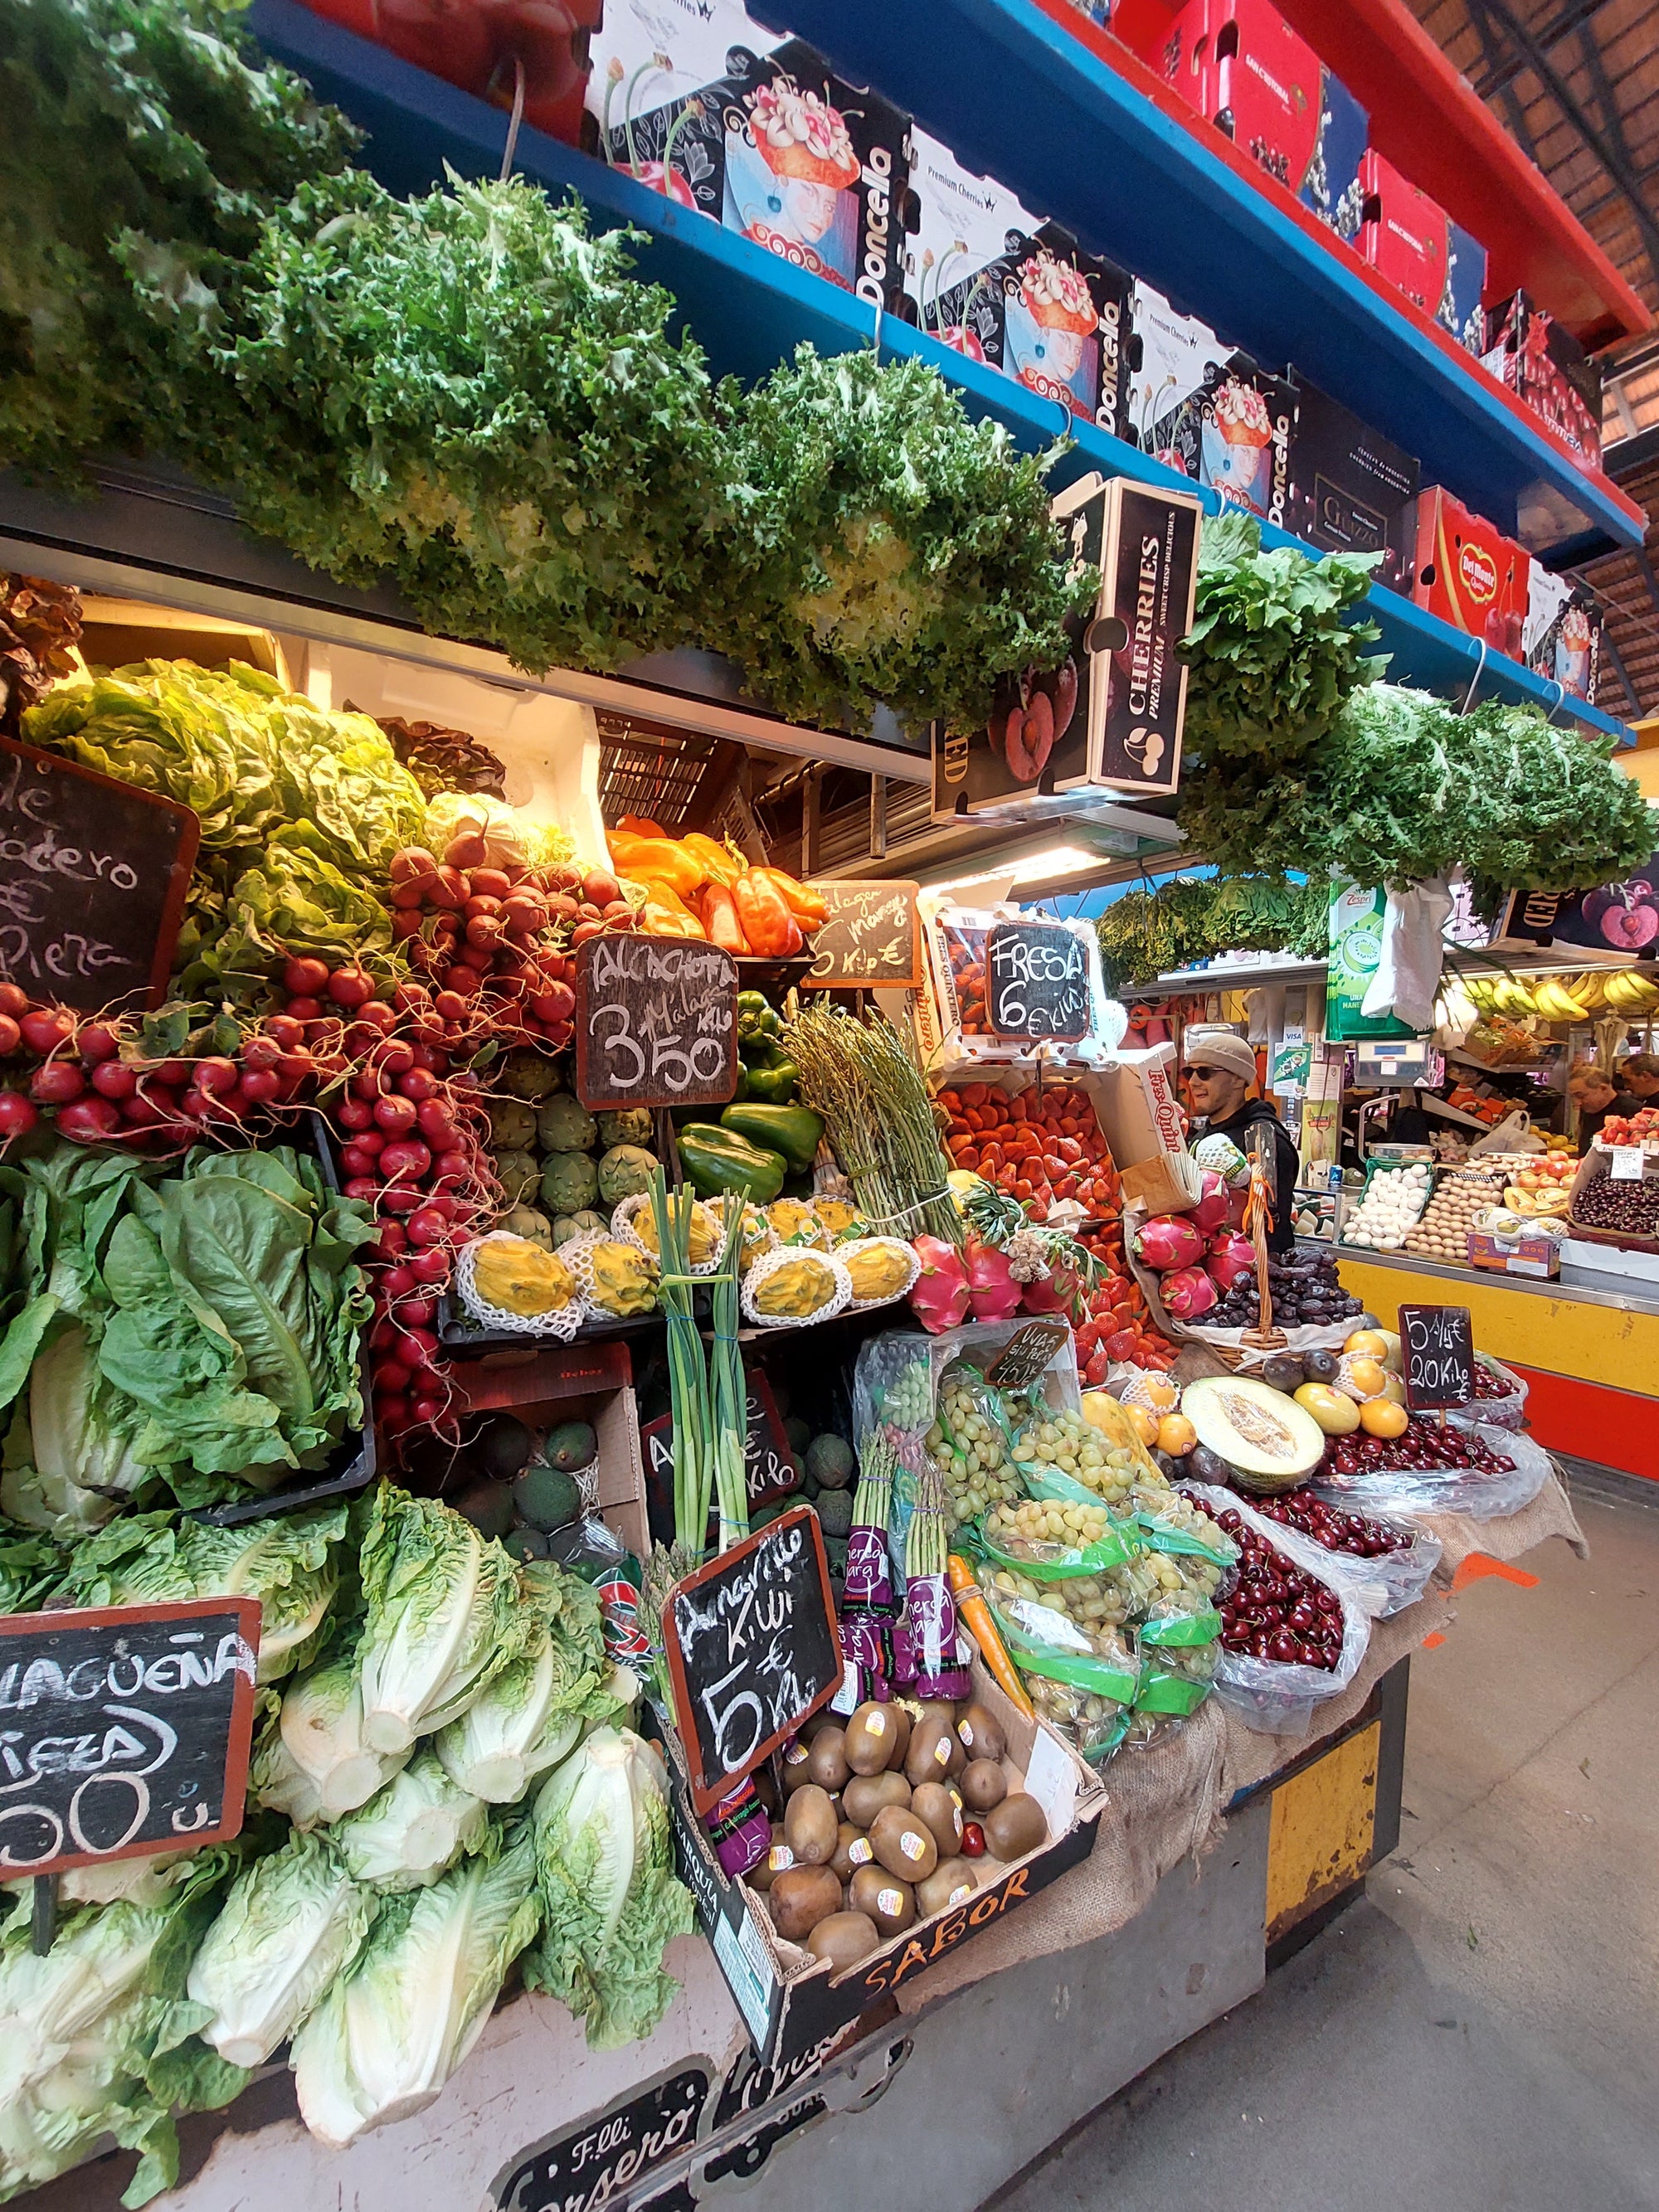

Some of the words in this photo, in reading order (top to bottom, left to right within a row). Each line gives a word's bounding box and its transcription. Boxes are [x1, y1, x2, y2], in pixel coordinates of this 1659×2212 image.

[927, 165, 957, 192] Premium
[958, 182, 983, 209] Cherries
[856, 146, 892, 309] Doncella
[1149, 314, 1170, 334] Premium
[1170, 326, 1189, 347] Cherries
[1096, 301, 1119, 435] Doncella
[1267, 415, 1289, 529] Doncella
[1164, 511, 1176, 563] DELICIOUS
[1161, 563, 1171, 595] CRISP
[1462, 555, 1474, 575] Del
[1474, 566, 1495, 587] Monte
[1129, 536, 1160, 716] CHERRIES
[1160, 593, 1170, 627] SWEET
[1147, 634, 1165, 720] PREMIUM
[1586, 626, 1599, 705] Doncella
[1346, 894, 1371, 906] Zespri
[878, 936, 905, 965] €
[936, 933, 950, 965] FRES
[988, 933, 1083, 982] FRESA
[941, 964, 961, 1027] QUINTERO
[999, 980, 1027, 1028] 6
[1026, 1007, 1048, 1038] €
[1021, 1326, 1059, 1348] UVAS
[1404, 1310, 1428, 1350] 5
[1408, 1354, 1438, 1388] 20
[1452, 1382, 1472, 1403] €
[0, 1631, 257, 1709] LAGUEÑA
[701, 1658, 762, 1773] 5
[756, 1625, 795, 1675] €
[865, 1868, 1029, 2001] SABOR
[533, 2103, 695, 2212] rsero
[572, 2117, 632, 2173] F.lli
